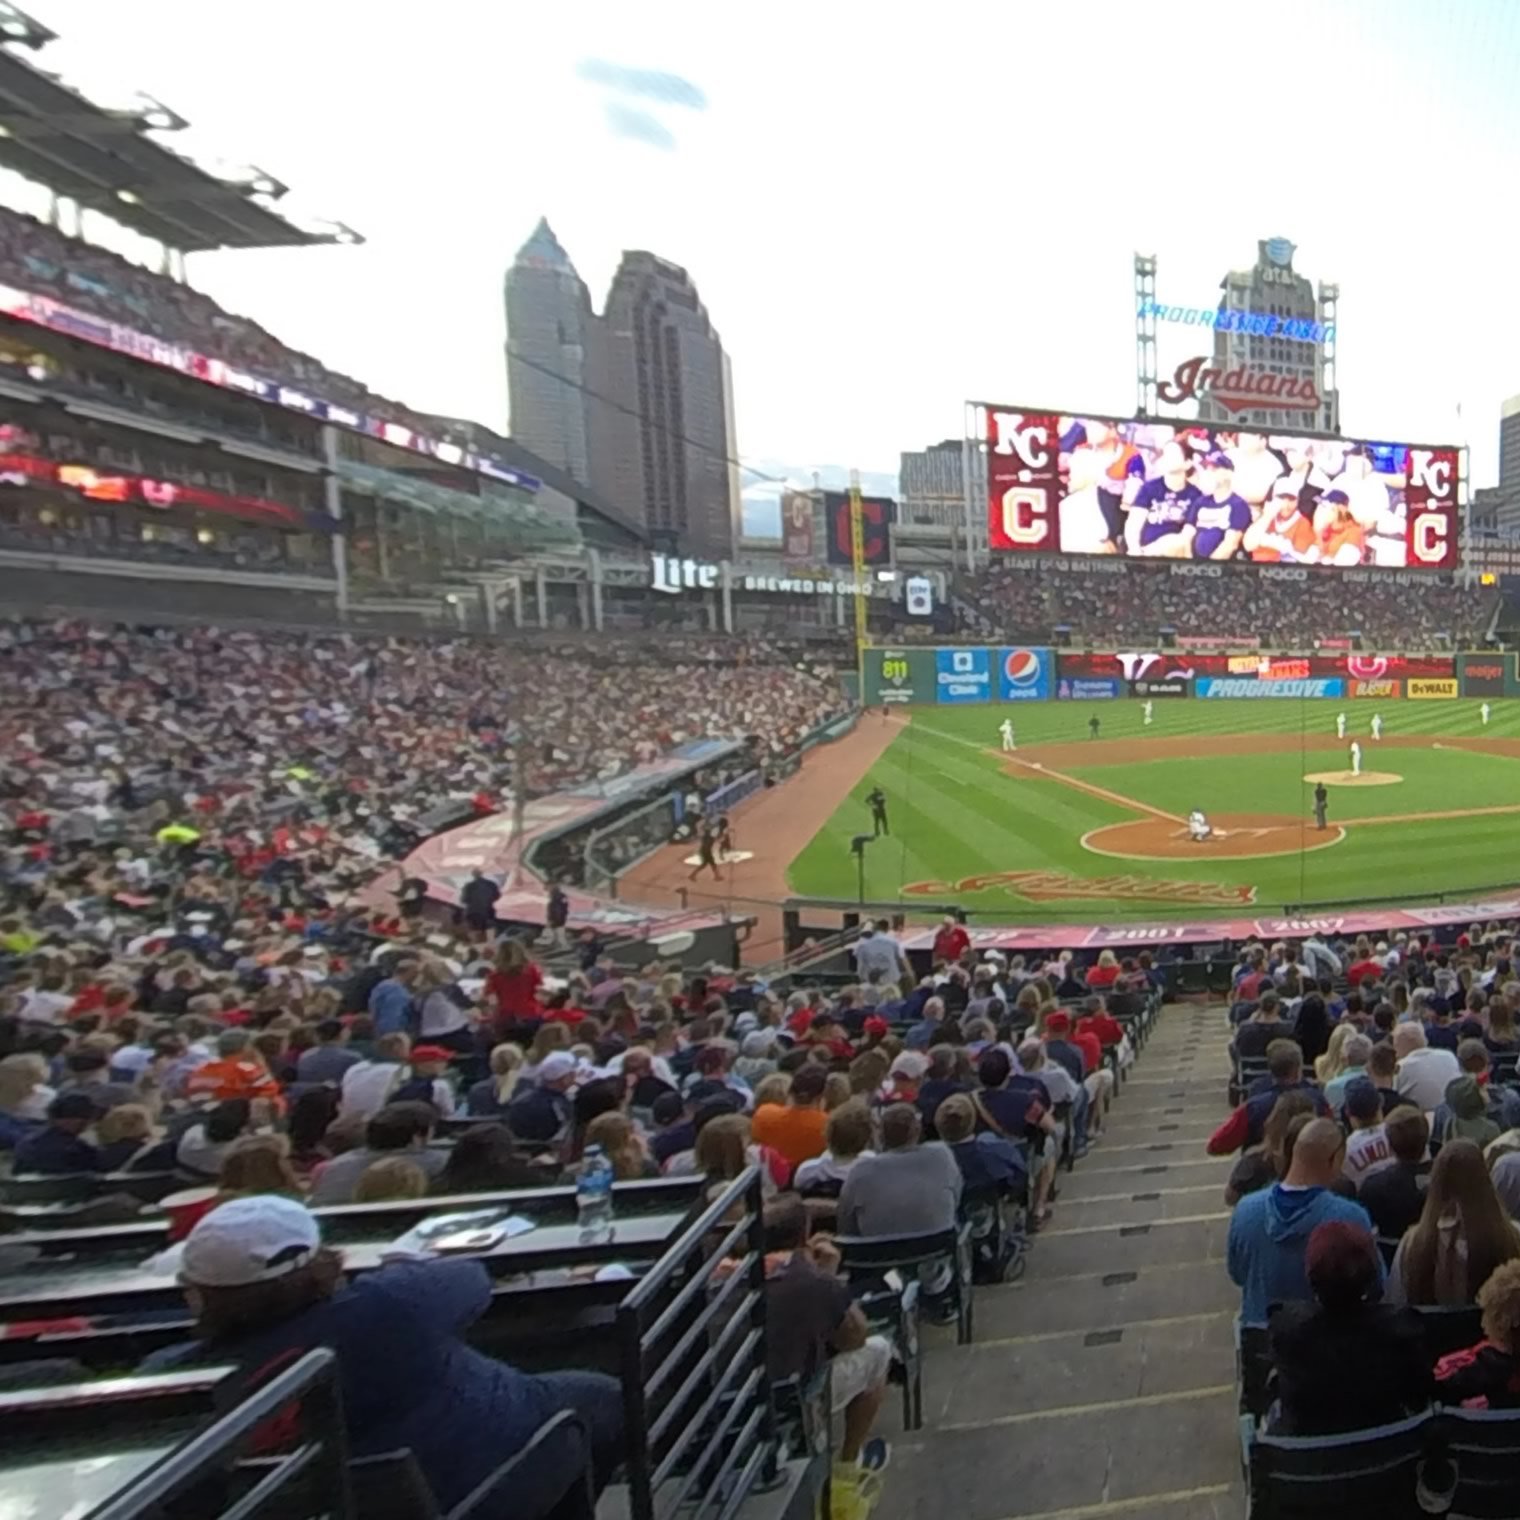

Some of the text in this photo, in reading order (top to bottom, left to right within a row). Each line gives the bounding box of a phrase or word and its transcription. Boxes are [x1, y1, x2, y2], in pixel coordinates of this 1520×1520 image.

[1157, 356, 1321, 408] Indians
[992, 413, 1049, 468] KC
[1409, 450, 1451, 498] KC
[1002, 486, 1048, 544] C
[1413, 512, 1448, 563] C
[652, 556, 718, 594] Lite
[745, 575, 814, 594] BREWED
[816, 578, 834, 595] IN
[1170, 564, 1222, 578] NOCO
[1258, 568, 1308, 582] NOCO
[883, 660, 907, 680] 811
[1206, 679, 1330, 698] PROGRESSIVE
[1271, 917, 1345, 932] 2007
